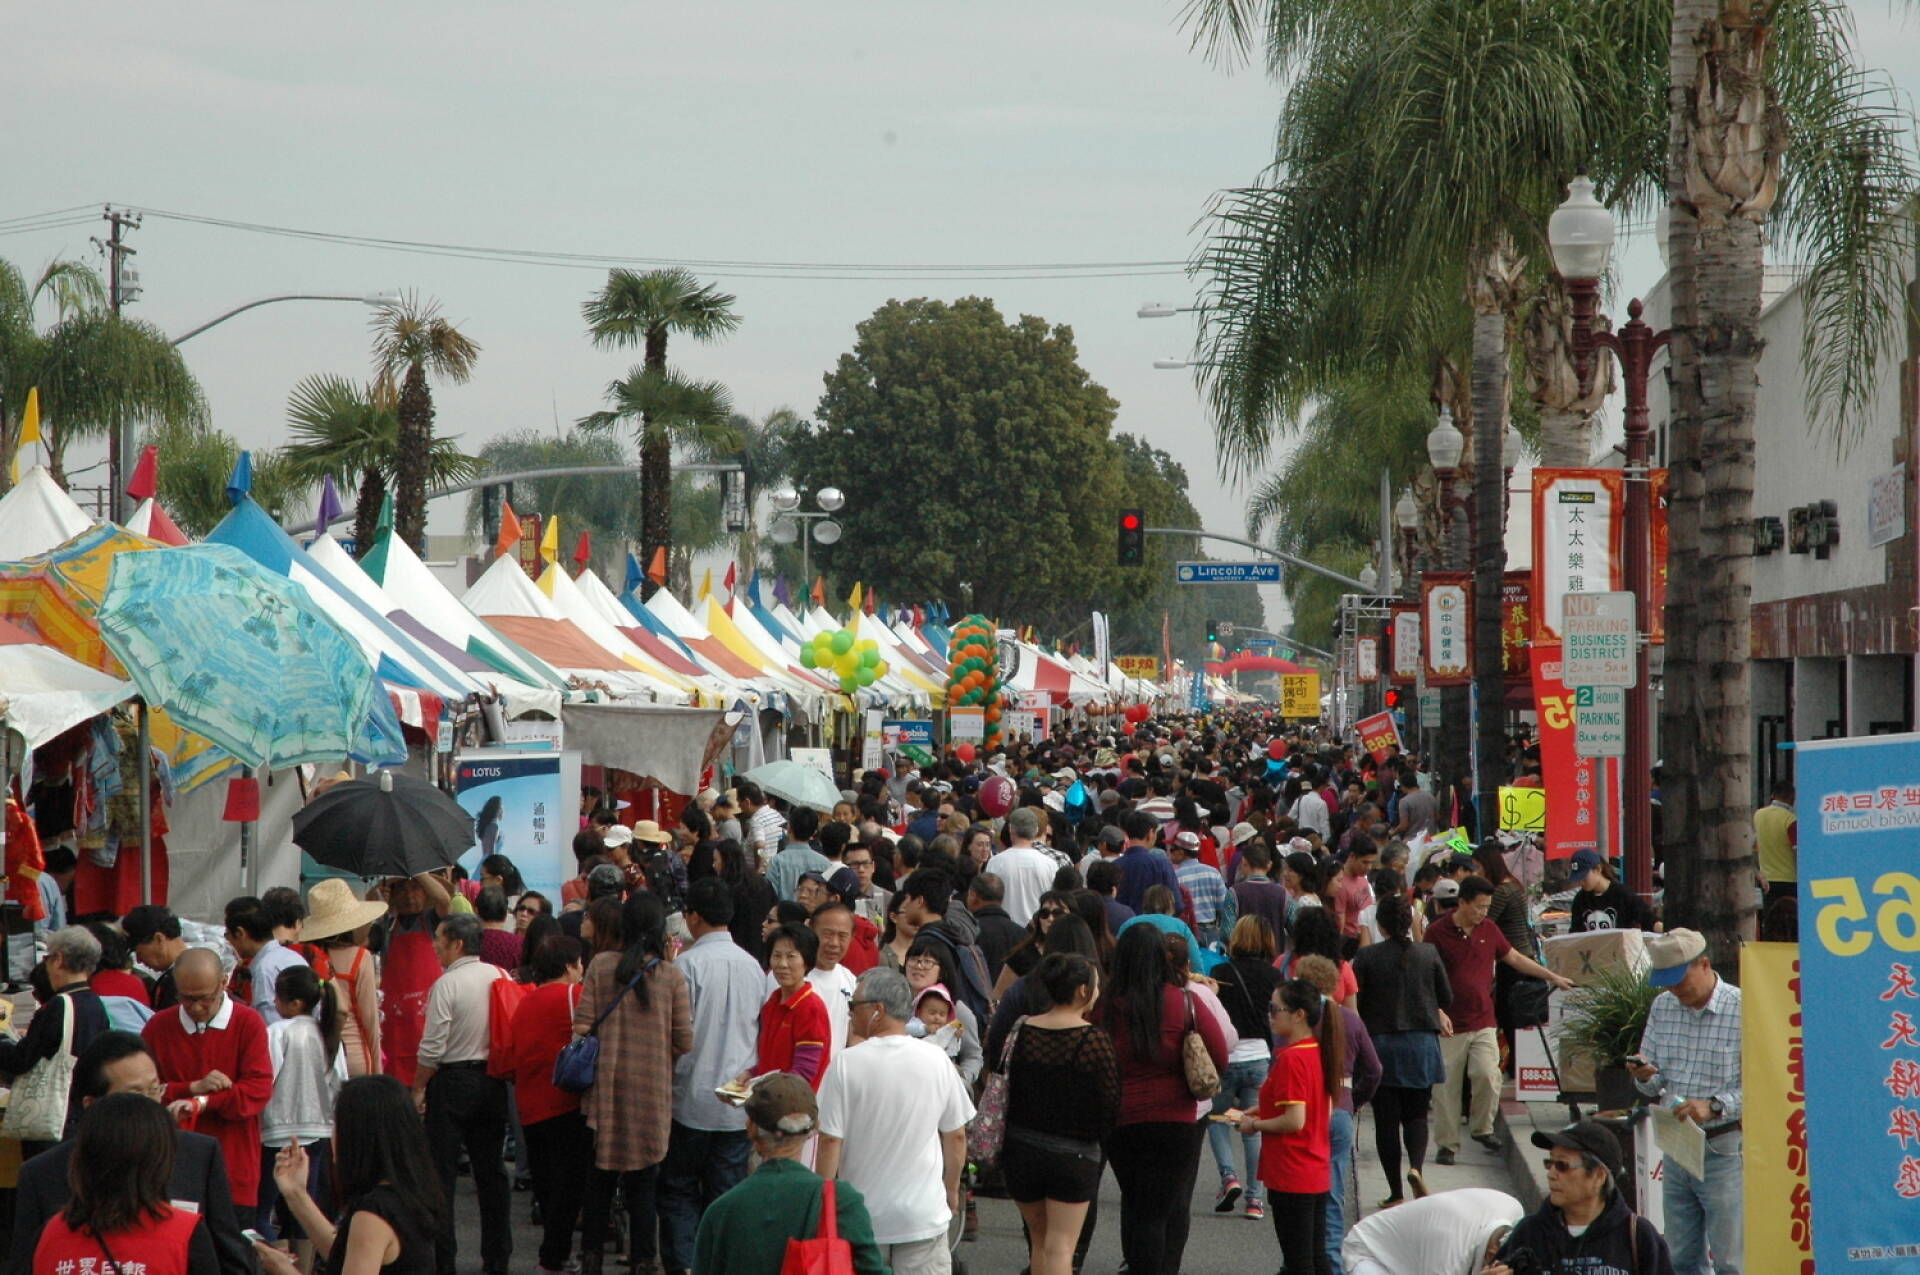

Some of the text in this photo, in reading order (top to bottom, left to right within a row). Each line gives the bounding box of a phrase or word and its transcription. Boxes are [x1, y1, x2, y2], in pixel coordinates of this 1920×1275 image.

[1568, 506, 1584, 591] 太太樂雞
[1198, 566, 1275, 576] Lincoln Ave
[1567, 597, 1592, 616] NO
[1568, 619, 1628, 632] PARKING
[1570, 634, 1626, 646] BUSINESS
[1570, 647, 1627, 659] DISTRICT
[1579, 689, 1620, 704] 2 HOUR
[1580, 712, 1620, 725] PARKING
[473, 767, 501, 777] LOTUS
